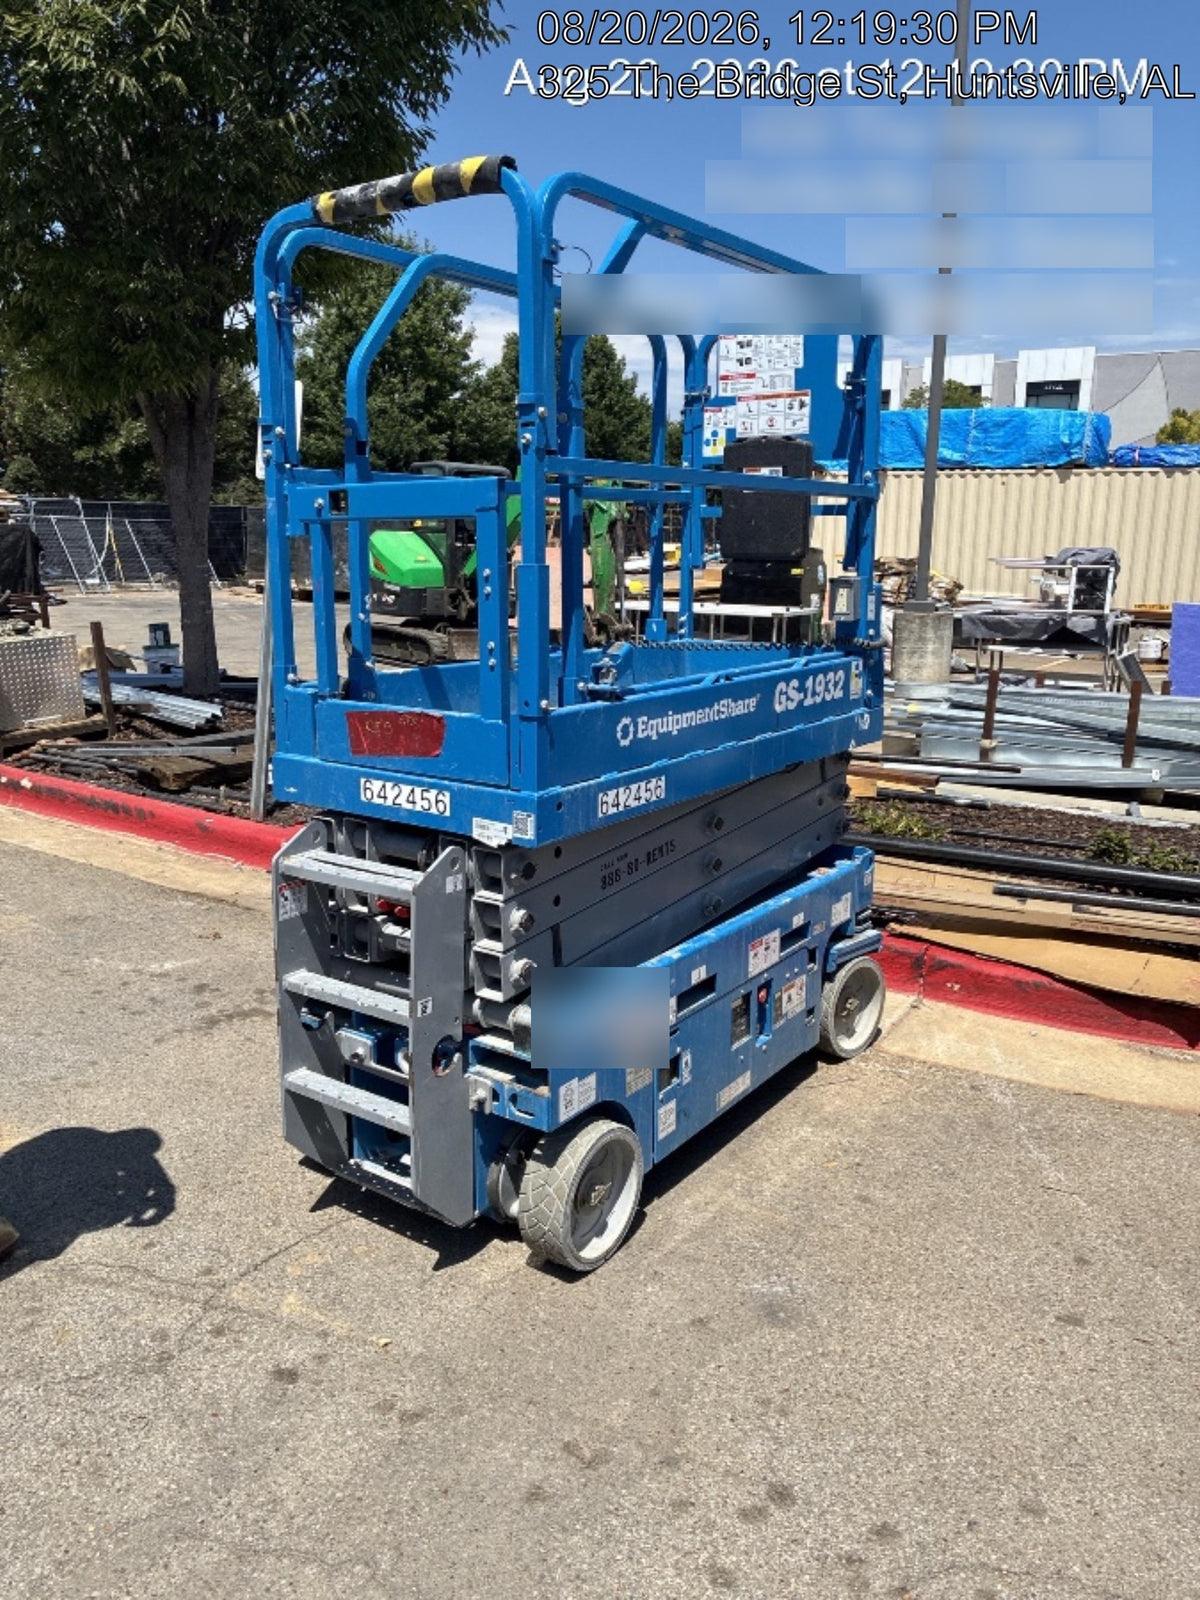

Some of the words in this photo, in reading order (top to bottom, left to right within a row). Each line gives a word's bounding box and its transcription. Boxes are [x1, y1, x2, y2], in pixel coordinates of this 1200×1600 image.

[774, 669, 846, 714] GS-1932
[636, 697, 757, 740] EquipmentShare
[361, 779, 449, 815] 642456
[600, 776, 664, 815] 642456
